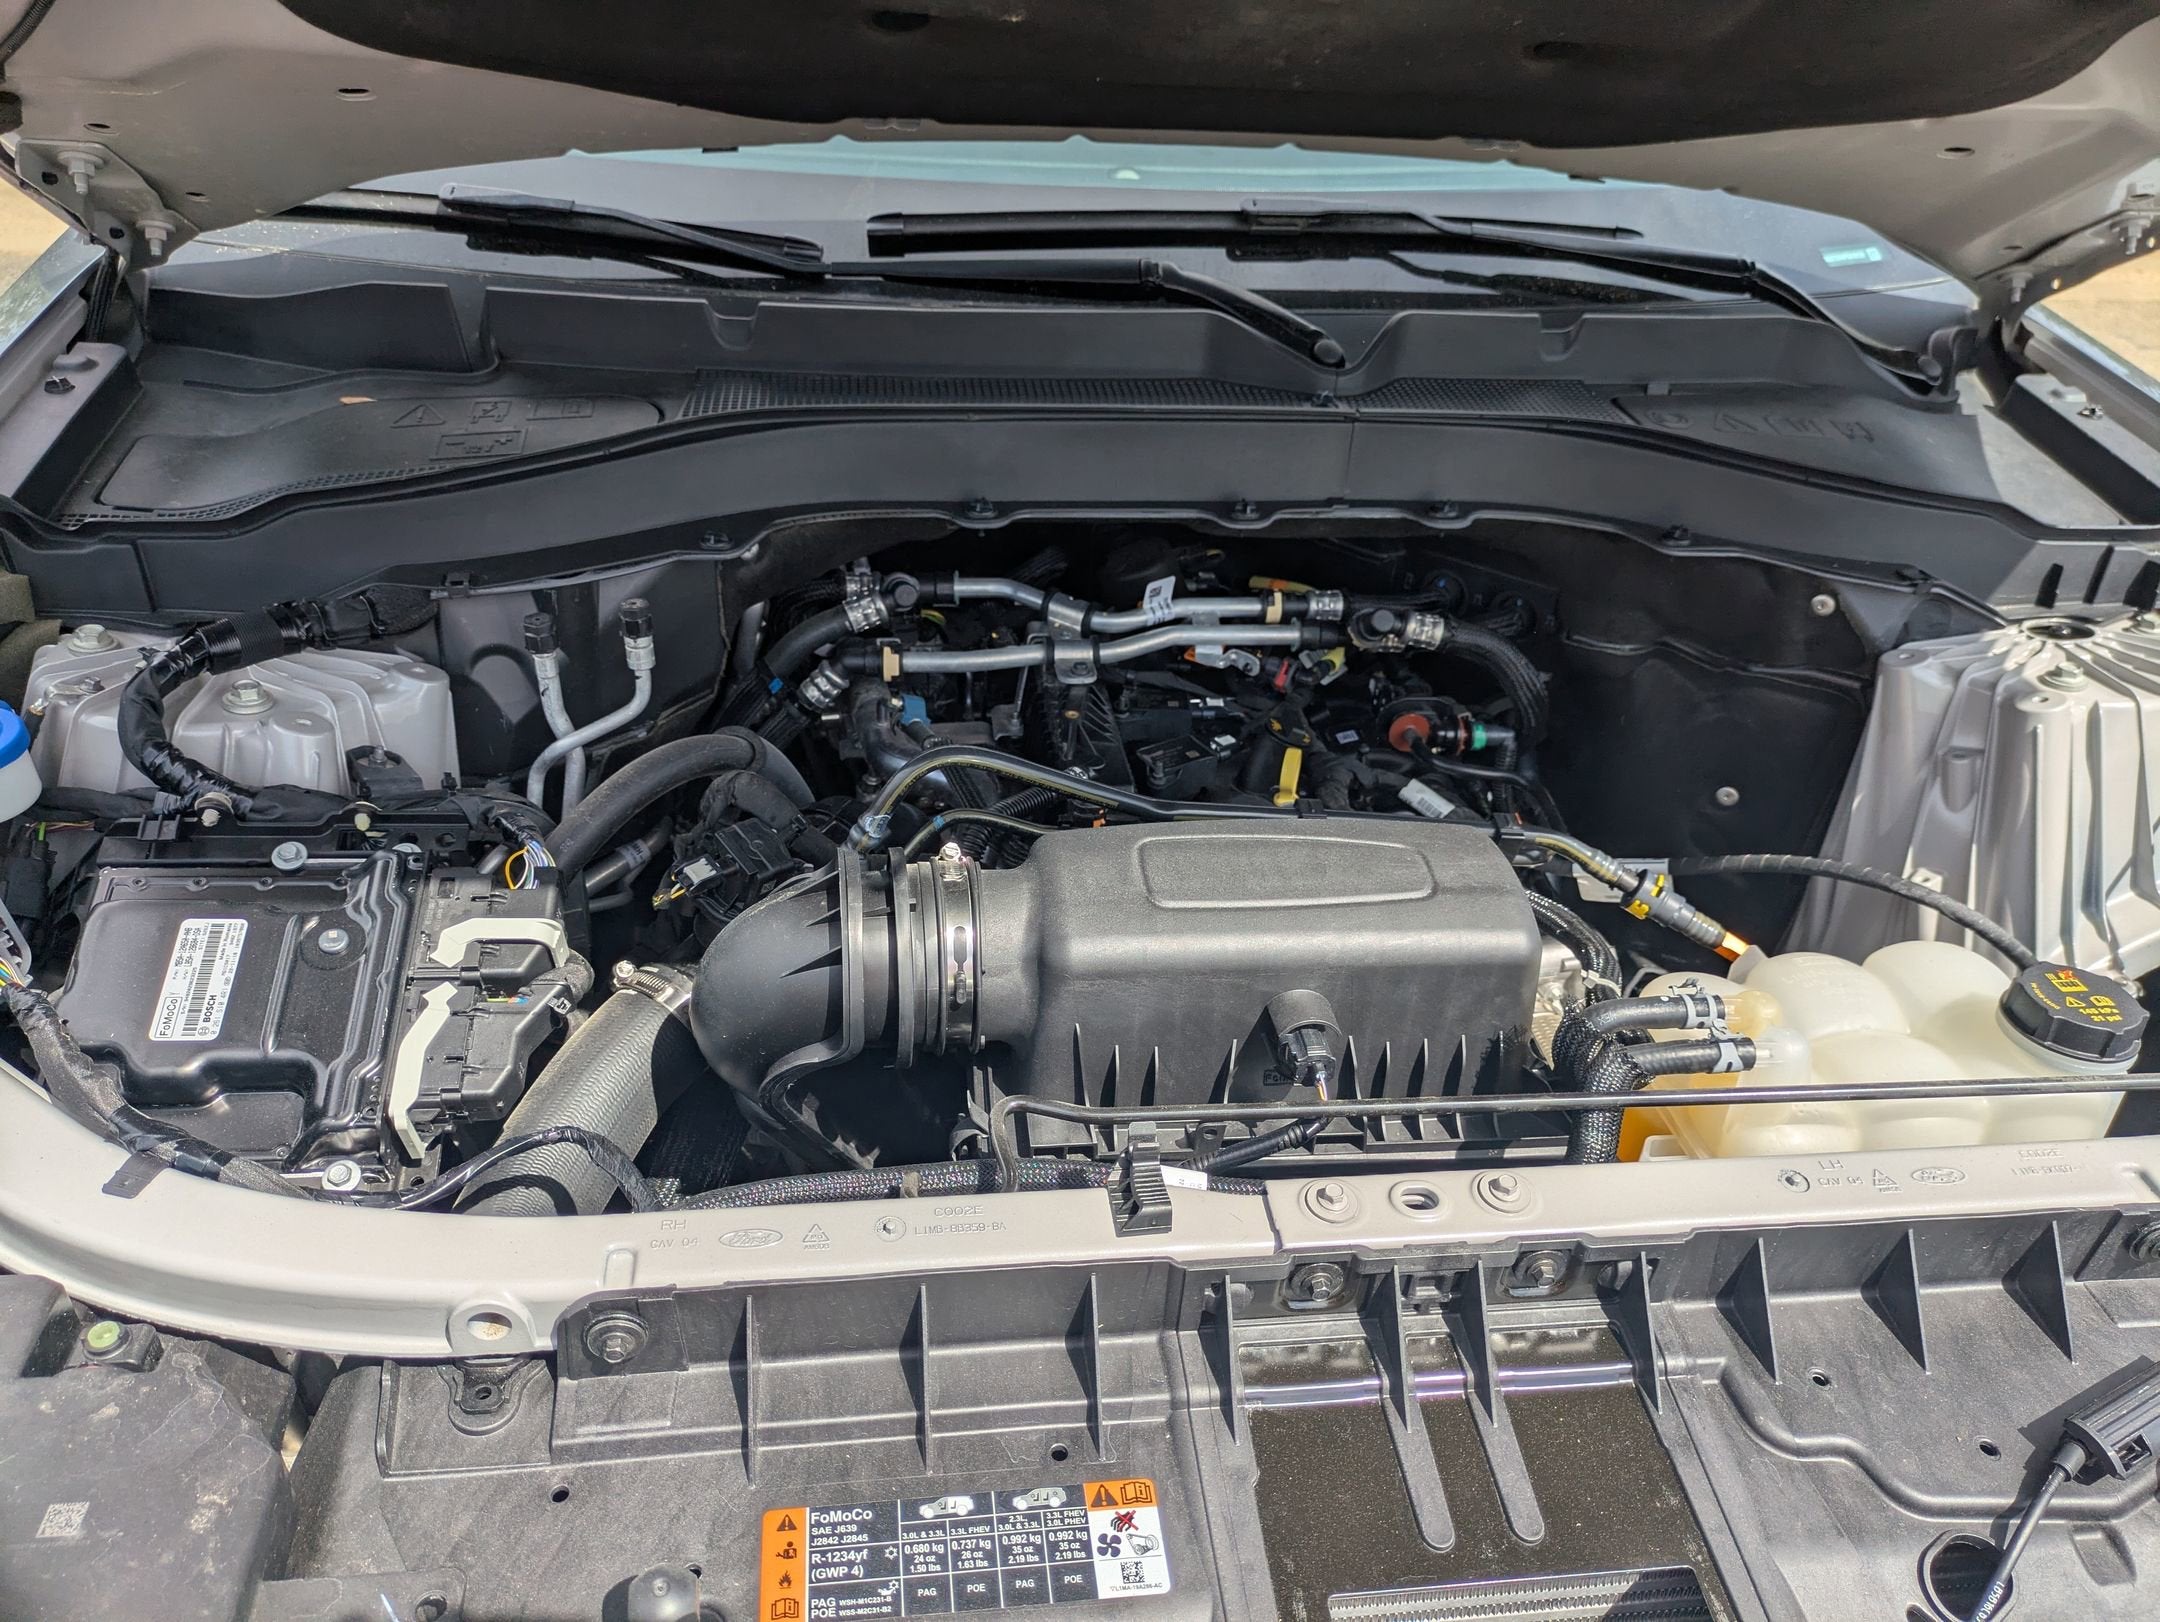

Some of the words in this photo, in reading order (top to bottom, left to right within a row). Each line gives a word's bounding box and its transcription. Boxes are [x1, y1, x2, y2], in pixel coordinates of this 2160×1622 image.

[203, 994, 217, 1023] BOSCH
[159, 998, 178, 1036] FoMoCo
[1818, 1159, 1844, 1170] LH
[661, 1219, 687, 1230] RH
[811, 1508, 873, 1525] FoMoCo
[1046, 1511, 1063, 1519] 3.3L
[1063, 1509, 1085, 1517] FHEV
[1016, 1522, 1023, 1530] &
[1023, 1521, 1040, 1529] 3.3L
[1046, 1519, 1063, 1527] 3.0L
[1064, 1517, 1086, 1525] PHEV
[811, 1526, 832, 1535] SAE
[834, 1524, 858, 1534] J639
[902, 1531, 919, 1540] 3.0L
[928, 1529, 945, 1537] 3.3L
[950, 1528, 967, 1536] 3.3L
[968, 1525, 990, 1534] FHEV
[1048, 1530, 1074, 1541] 0.992
[1076, 1529, 1088, 1541] kg
[811, 1536, 839, 1546] J2842
[840, 1533, 869, 1543] J2845
[951, 1539, 977, 1550] 0.737
[979, 1538, 991, 1549] kg
[1002, 1534, 1027, 1545] 0.992
[1029, 1533, 1041, 1544] kg
[904, 1543, 930, 1554] 0.680
[932, 1542, 944, 1554] kg
[1012, 1545, 1022, 1554] 35
[1023, 1545, 1034, 1553] oz
[1059, 1541, 1069, 1550] 35
[1070, 1541, 1081, 1549] oz
[811, 1549, 869, 1564] R-1234yf
[914, 1554, 924, 1563] 24
[925, 1554, 936, 1562] oz
[961, 1550, 972, 1559] 26
[973, 1550, 983, 1558] oz
[1008, 1554, 1025, 1564] 2.19
[1026, 1554, 1040, 1562] lbs
[1054, 1551, 1072, 1560] 2.19
[1073, 1550, 1086, 1558] lbs
[910, 1564, 927, 1573] 1.50
[928, 1563, 941, 1571] lbs
[957, 1559, 974, 1569] 1.63
[976, 1559, 989, 1567] lbs
[811, 1566, 848, 1582] (GWP
[851, 1564, 864, 1578] 4)
[1015, 1579, 1035, 1589] PAG
[1064, 1574, 1083, 1584] POE
[918, 1587, 937, 1597] PAG
[967, 1583, 986, 1593] POE
[811, 1597, 836, 1609] PAG
[811, 1607, 837, 1619] POE
